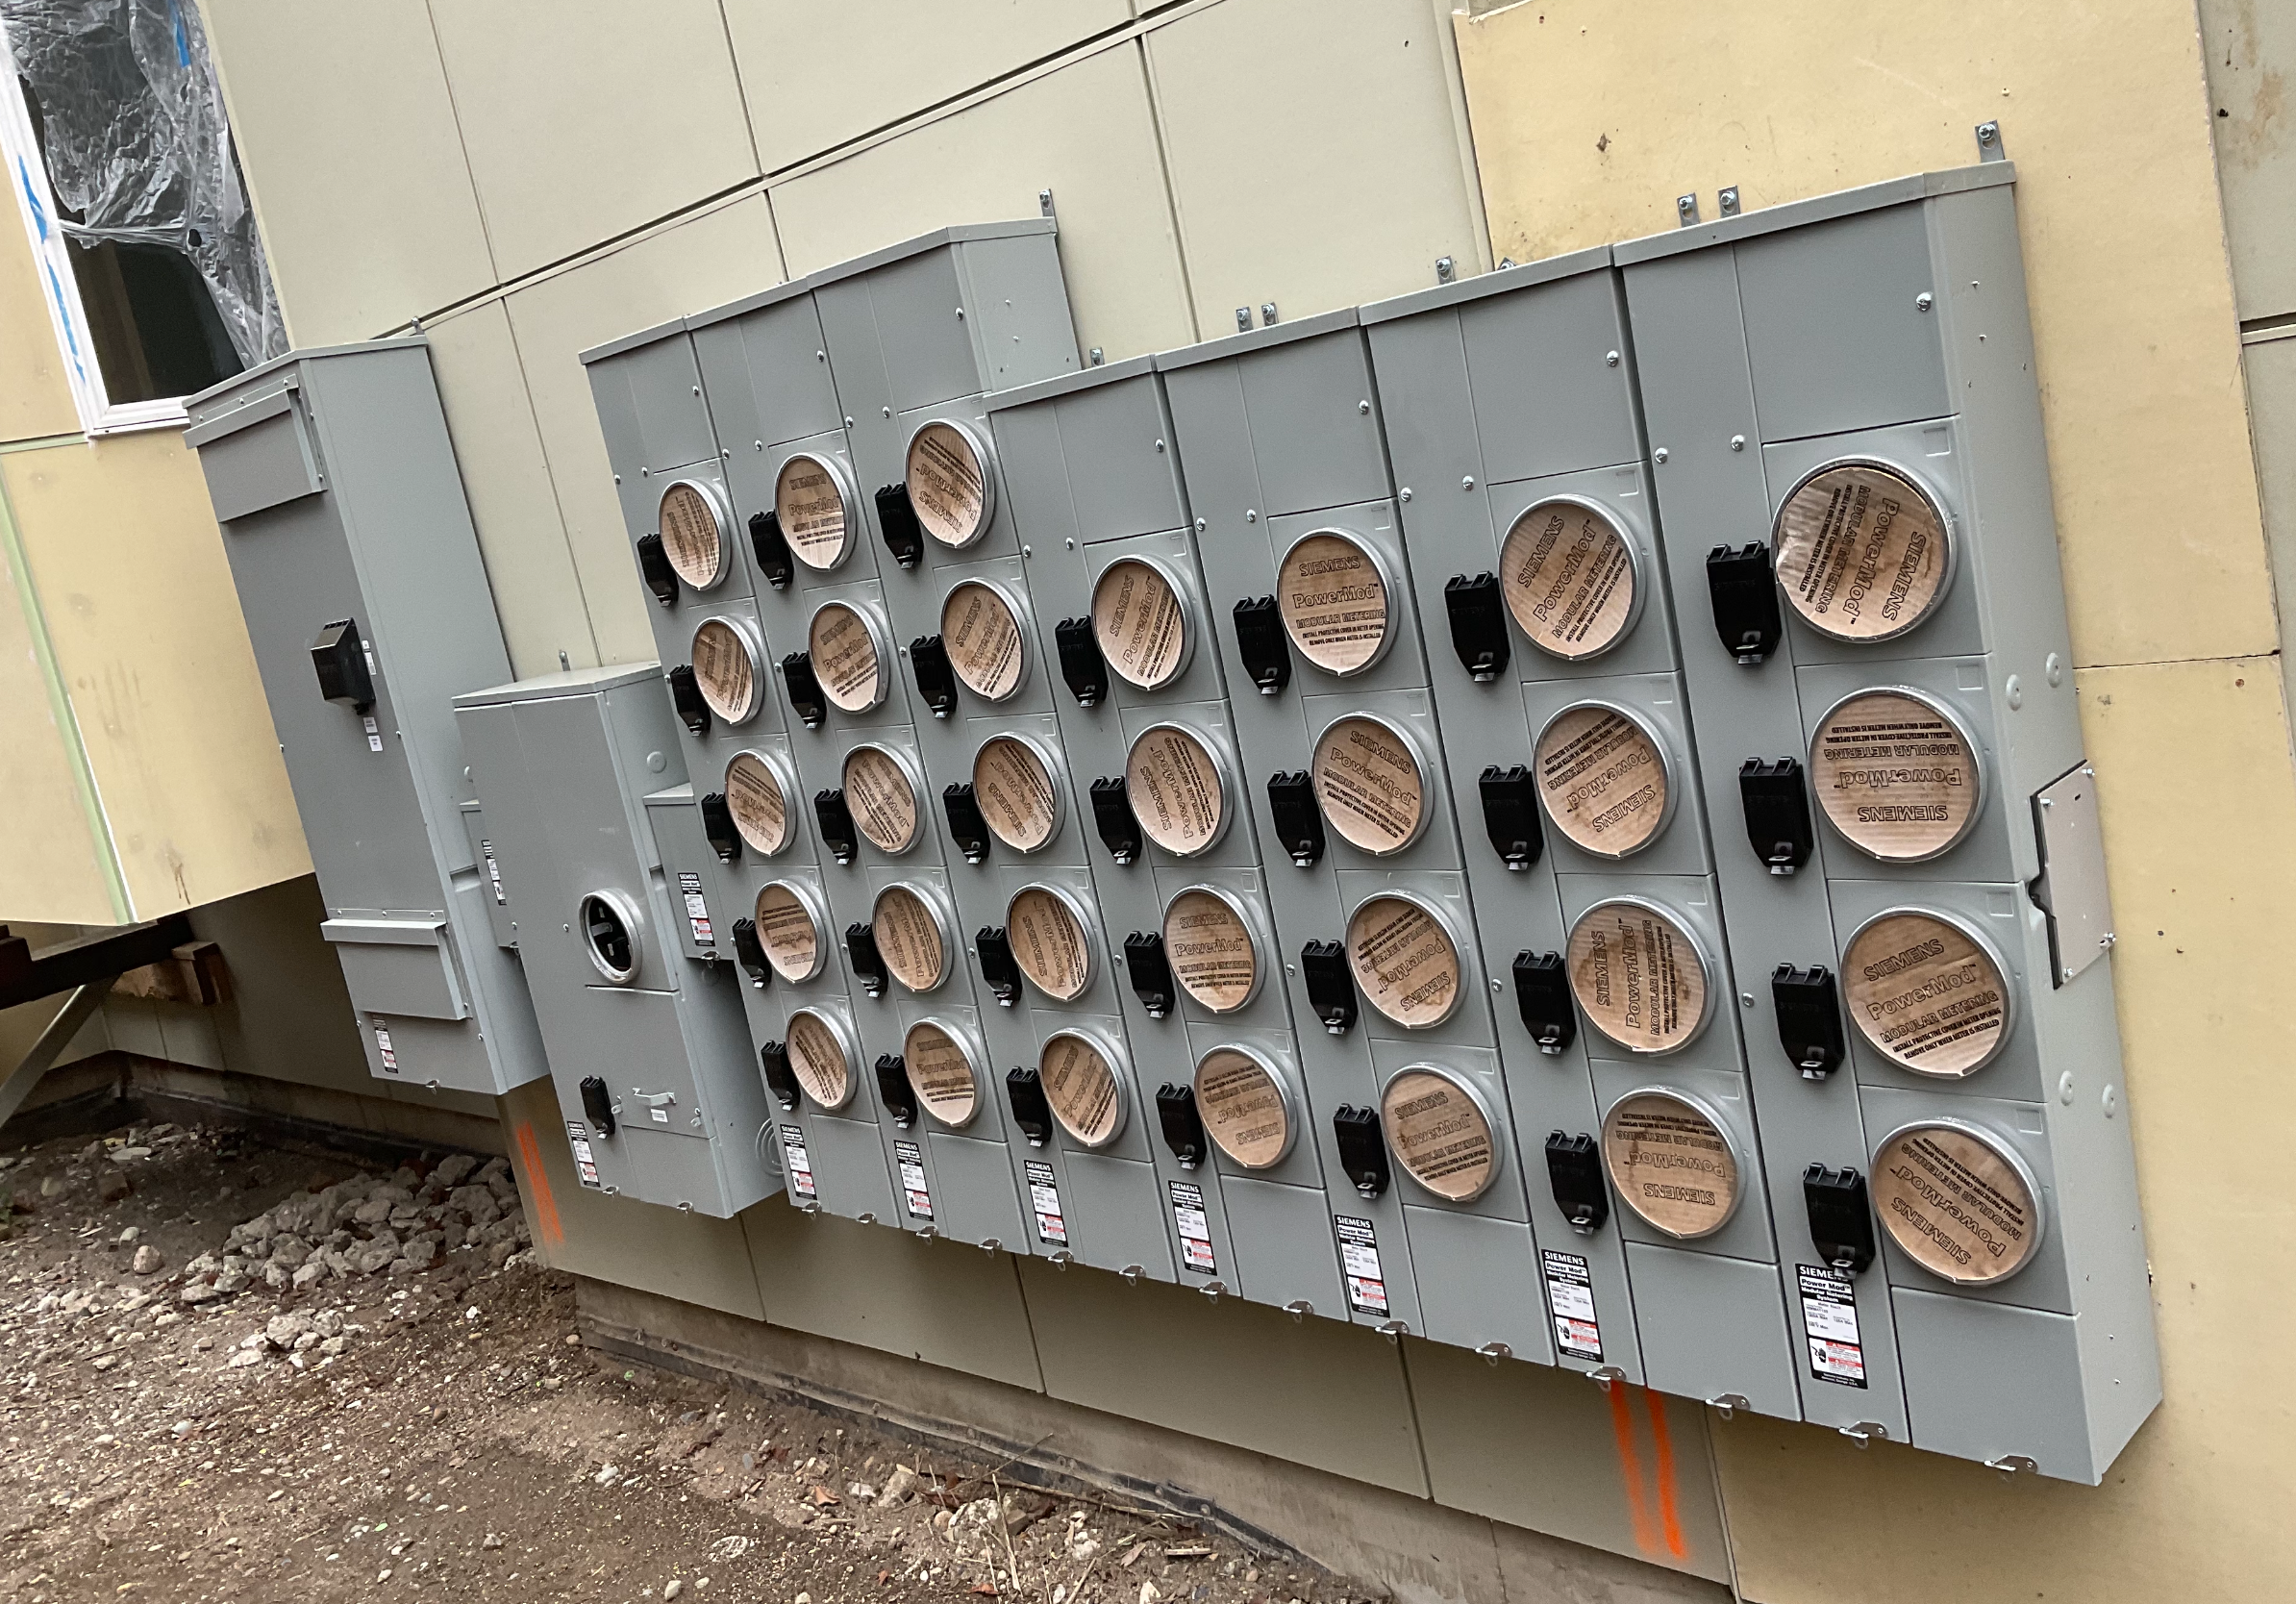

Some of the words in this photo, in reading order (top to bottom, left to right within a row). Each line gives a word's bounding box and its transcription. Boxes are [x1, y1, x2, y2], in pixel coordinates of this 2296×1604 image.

[1839, 483, 1873, 548] MODULAR
[1299, 555, 1360, 576] SIEMENS
[1517, 513, 1565, 589] SIEMENS
[1554, 585, 1588, 638] MODULAR
[1584, 533, 1617, 588] METERING
[1816, 547, 1848, 615] METERING
[1881, 530, 1927, 622] SIEMENS
[1110, 573, 1135, 638] SIEMENS
[1350, 729, 1411, 774] SIEMENS
[1593, 725, 1639, 760] MODULAR
[1823, 746, 1890, 759] METERING
[1893, 744, 1959, 756] MODULAR
[1548, 754, 1594, 791] METERING
[1139, 765, 1173, 830] SIEMENS
[1591, 783, 1656, 833] SIEMENS
[1857, 805, 1947, 821] SIEMENS
[1643, 918, 1657, 976] METERING
[1862, 937, 1945, 982] SIEMENS
[1591, 928, 1610, 1006] SIEMENS
[1399, 970, 1451, 1012] SIEMENS
[1649, 977, 1660, 1033] MODULAR
[1879, 1013, 1939, 1042] MODULAR
[1937, 989, 1999, 1020] METERING
[1892, 1039, 1914, 1051] INSTALL
[1912, 1029, 1942, 1044] PROTECTIVE
[1940, 1023, 1958, 1034] COVER
[1962, 1015, 1980, 1025] METER
[1978, 1006, 2002, 1019] OPENING
[1904, 1045, 1926, 1058] REMOVE
[1925, 1040, 1940, 1051] ONLY
[1936, 1036, 1954, 1046] WHEN
[1952, 1029, 1970, 1040] METER
[1974, 1017, 2000, 1032] INSTALLED
[1393, 1090, 1448, 1119] SIEMENS
[1909, 1139, 1934, 1158] OPENING
[1921, 1138, 1949, 1159] INSTALLED
[1933, 1156, 1951, 1170] METER
[1026, 1162, 1051, 1171] SIEMENS
[1898, 1142, 1962, 1192] METERING
[1953, 1161, 1972, 1176] METER
[1956, 1172, 1974, 1188] COVER
[1969, 1173, 1987, 1189] WHEN
[1170, 1182, 1199, 1192] SIEMENS
[1643, 1182, 1714, 1205] SIEMENS
[1971, 1185, 2003, 1210] PROTECTIVE
[1984, 1185, 2001, 1197] ONLY
[1960, 1190, 2021, 1240] MODULAR
[1998, 1195, 2021, 1215] REMOVE
[2000, 1207, 2023, 1226] INSTALL
[1337, 1216, 1370, 1228] SIEMENS
[1888, 1195, 1972, 1265] SIEMENS
[1545, 1251, 1584, 1266] SIEMENS
[1800, 1266, 1848, 1281] SIEME
[1801, 1278, 1826, 1289] Power
